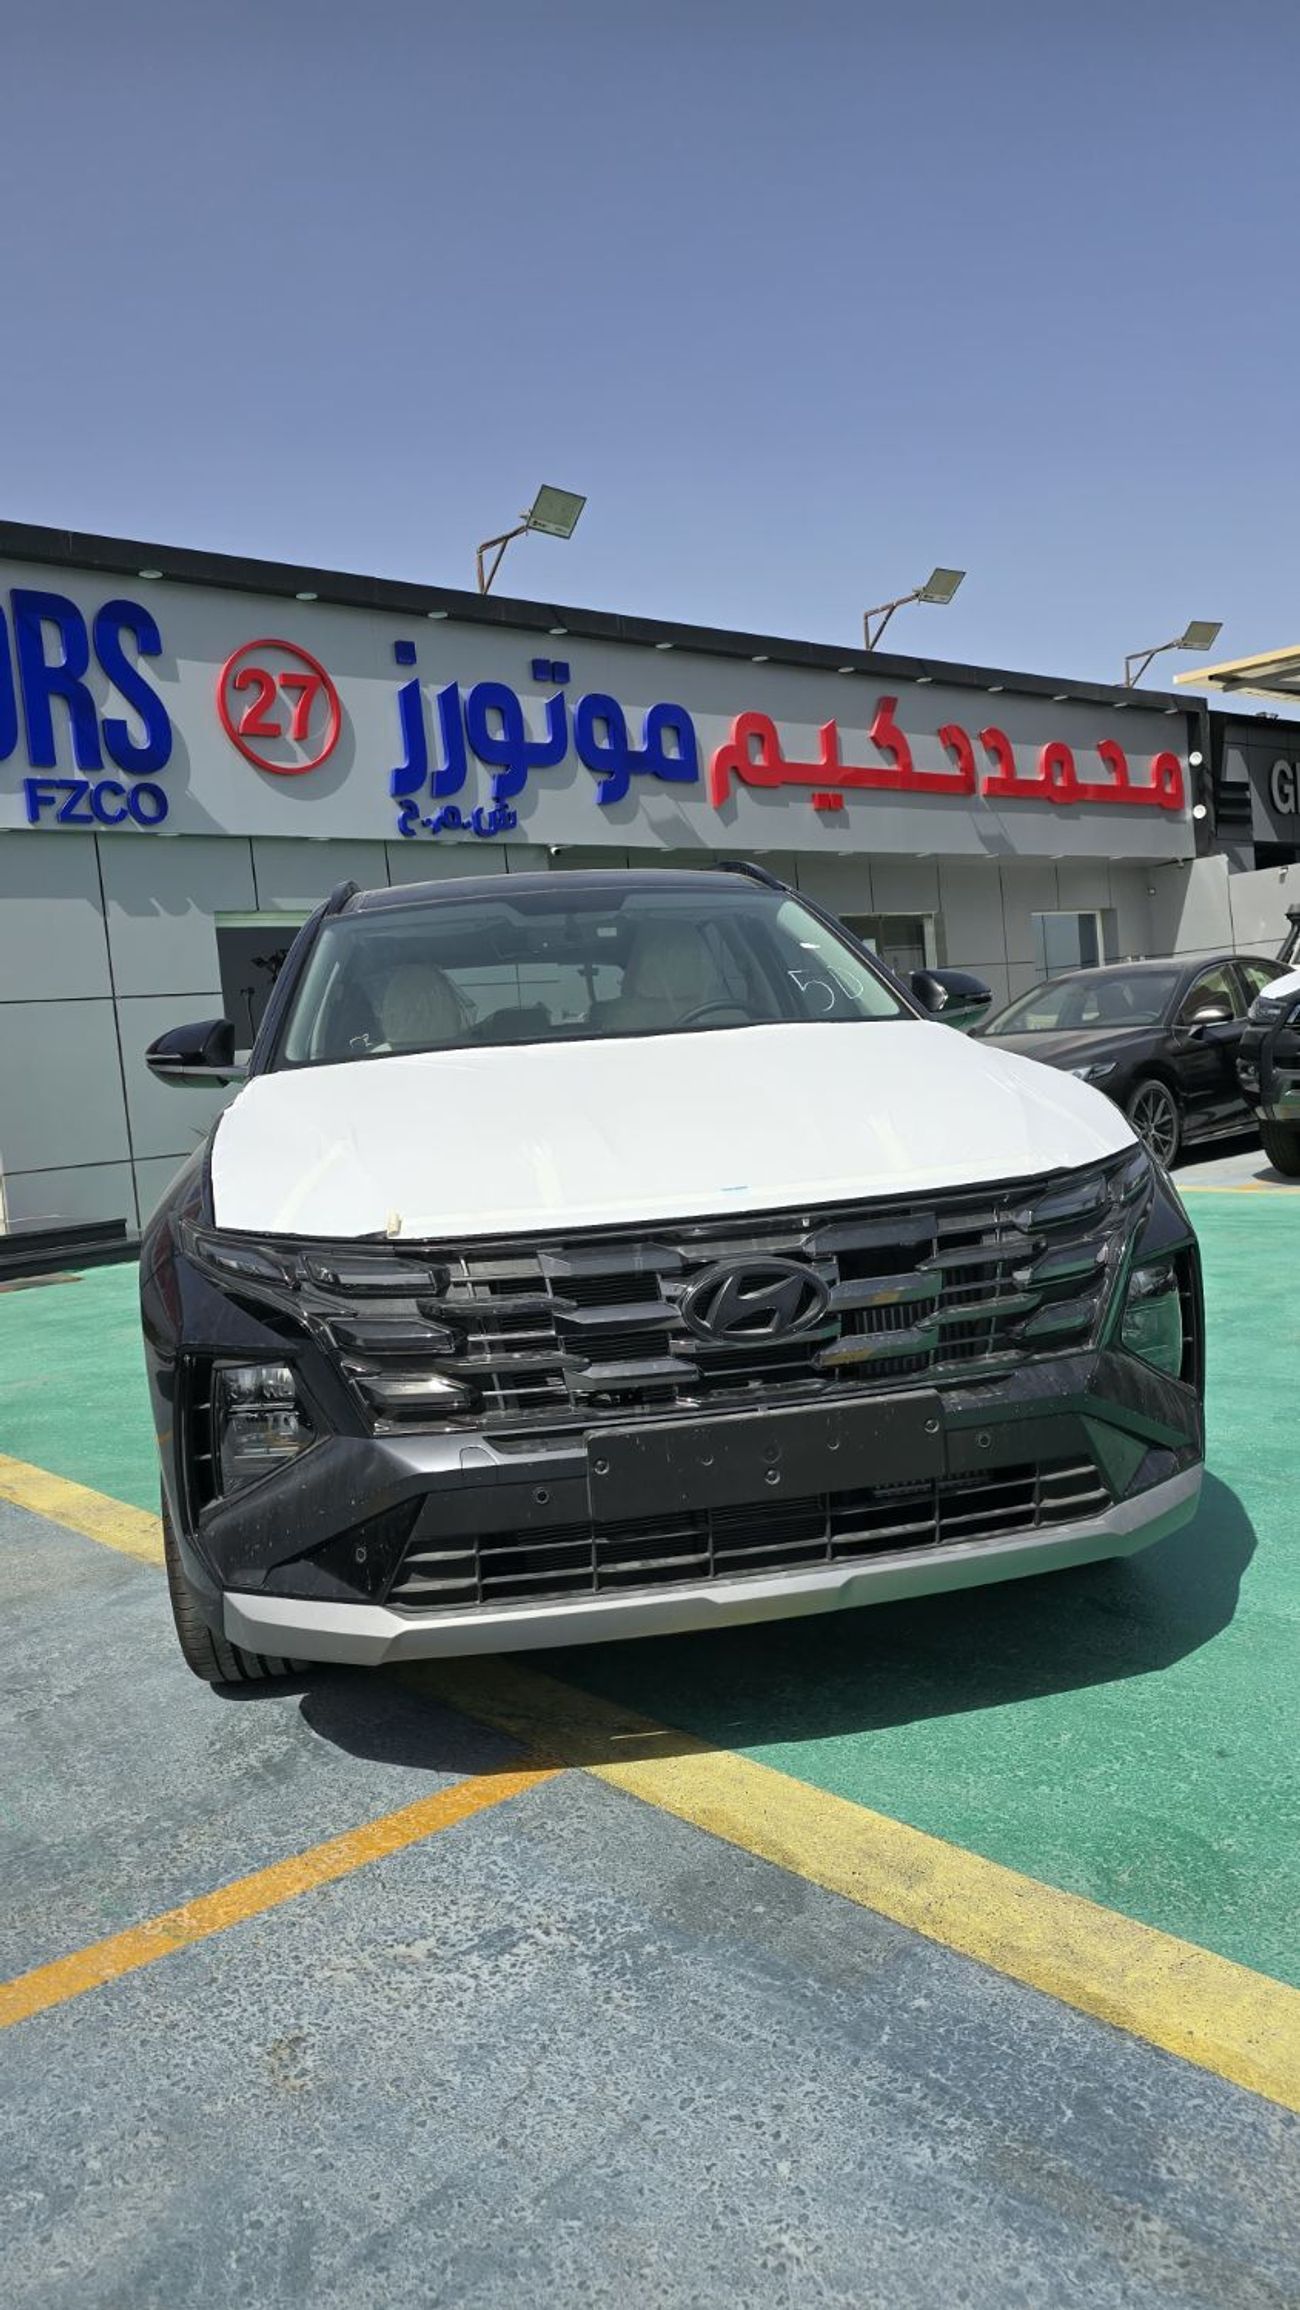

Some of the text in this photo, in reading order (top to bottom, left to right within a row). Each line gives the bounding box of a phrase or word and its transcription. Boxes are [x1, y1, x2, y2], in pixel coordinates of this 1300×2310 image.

[234, 667, 323, 740] 27
[390, 640, 1184, 810] محمد حكيم موتورز
[24, 778, 168, 826] FZCO
[1271, 759, 1300, 814] G
[788, 965, 863, 1012] 50
